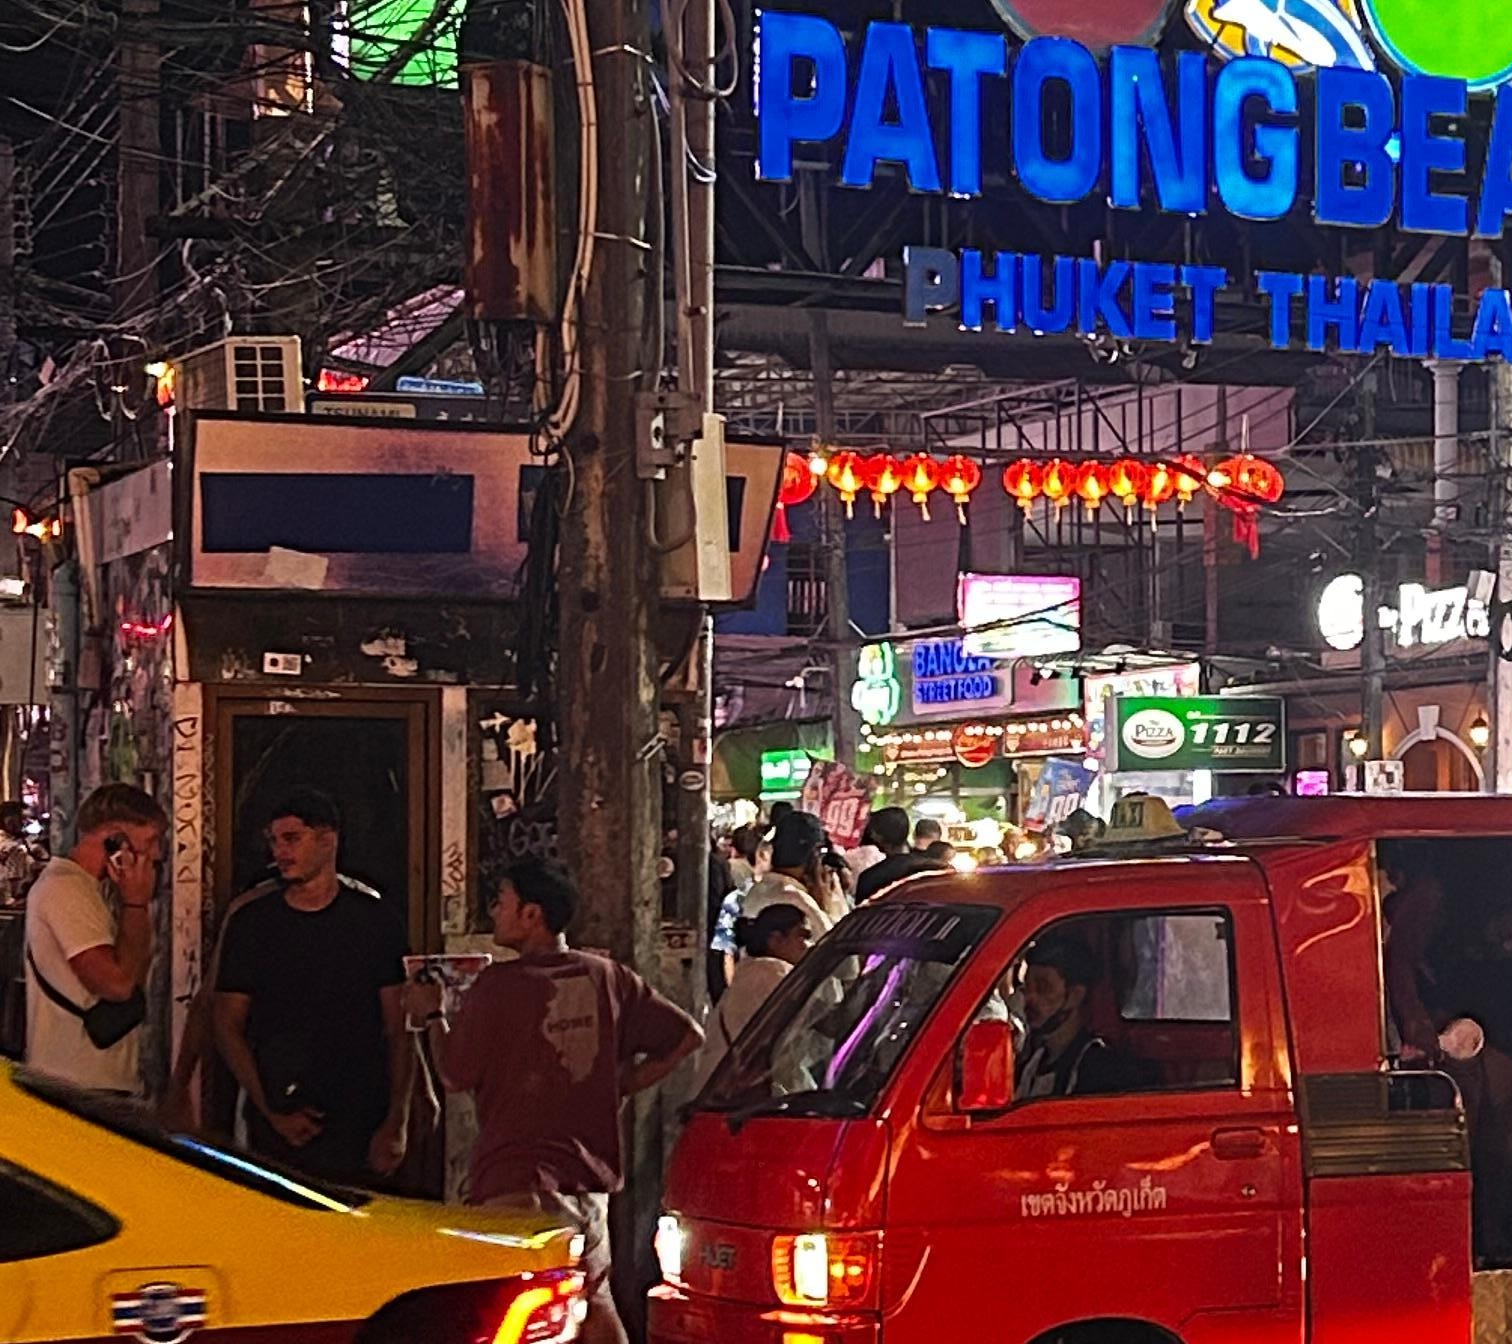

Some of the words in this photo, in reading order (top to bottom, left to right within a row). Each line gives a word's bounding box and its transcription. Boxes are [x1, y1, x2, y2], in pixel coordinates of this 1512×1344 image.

[753, 9, 1300, 220] PATONG
[903, 244, 1227, 344] PHUKET
[1135, 724, 1175, 738] PIZZA
[1189, 722, 1277, 744] 1112
